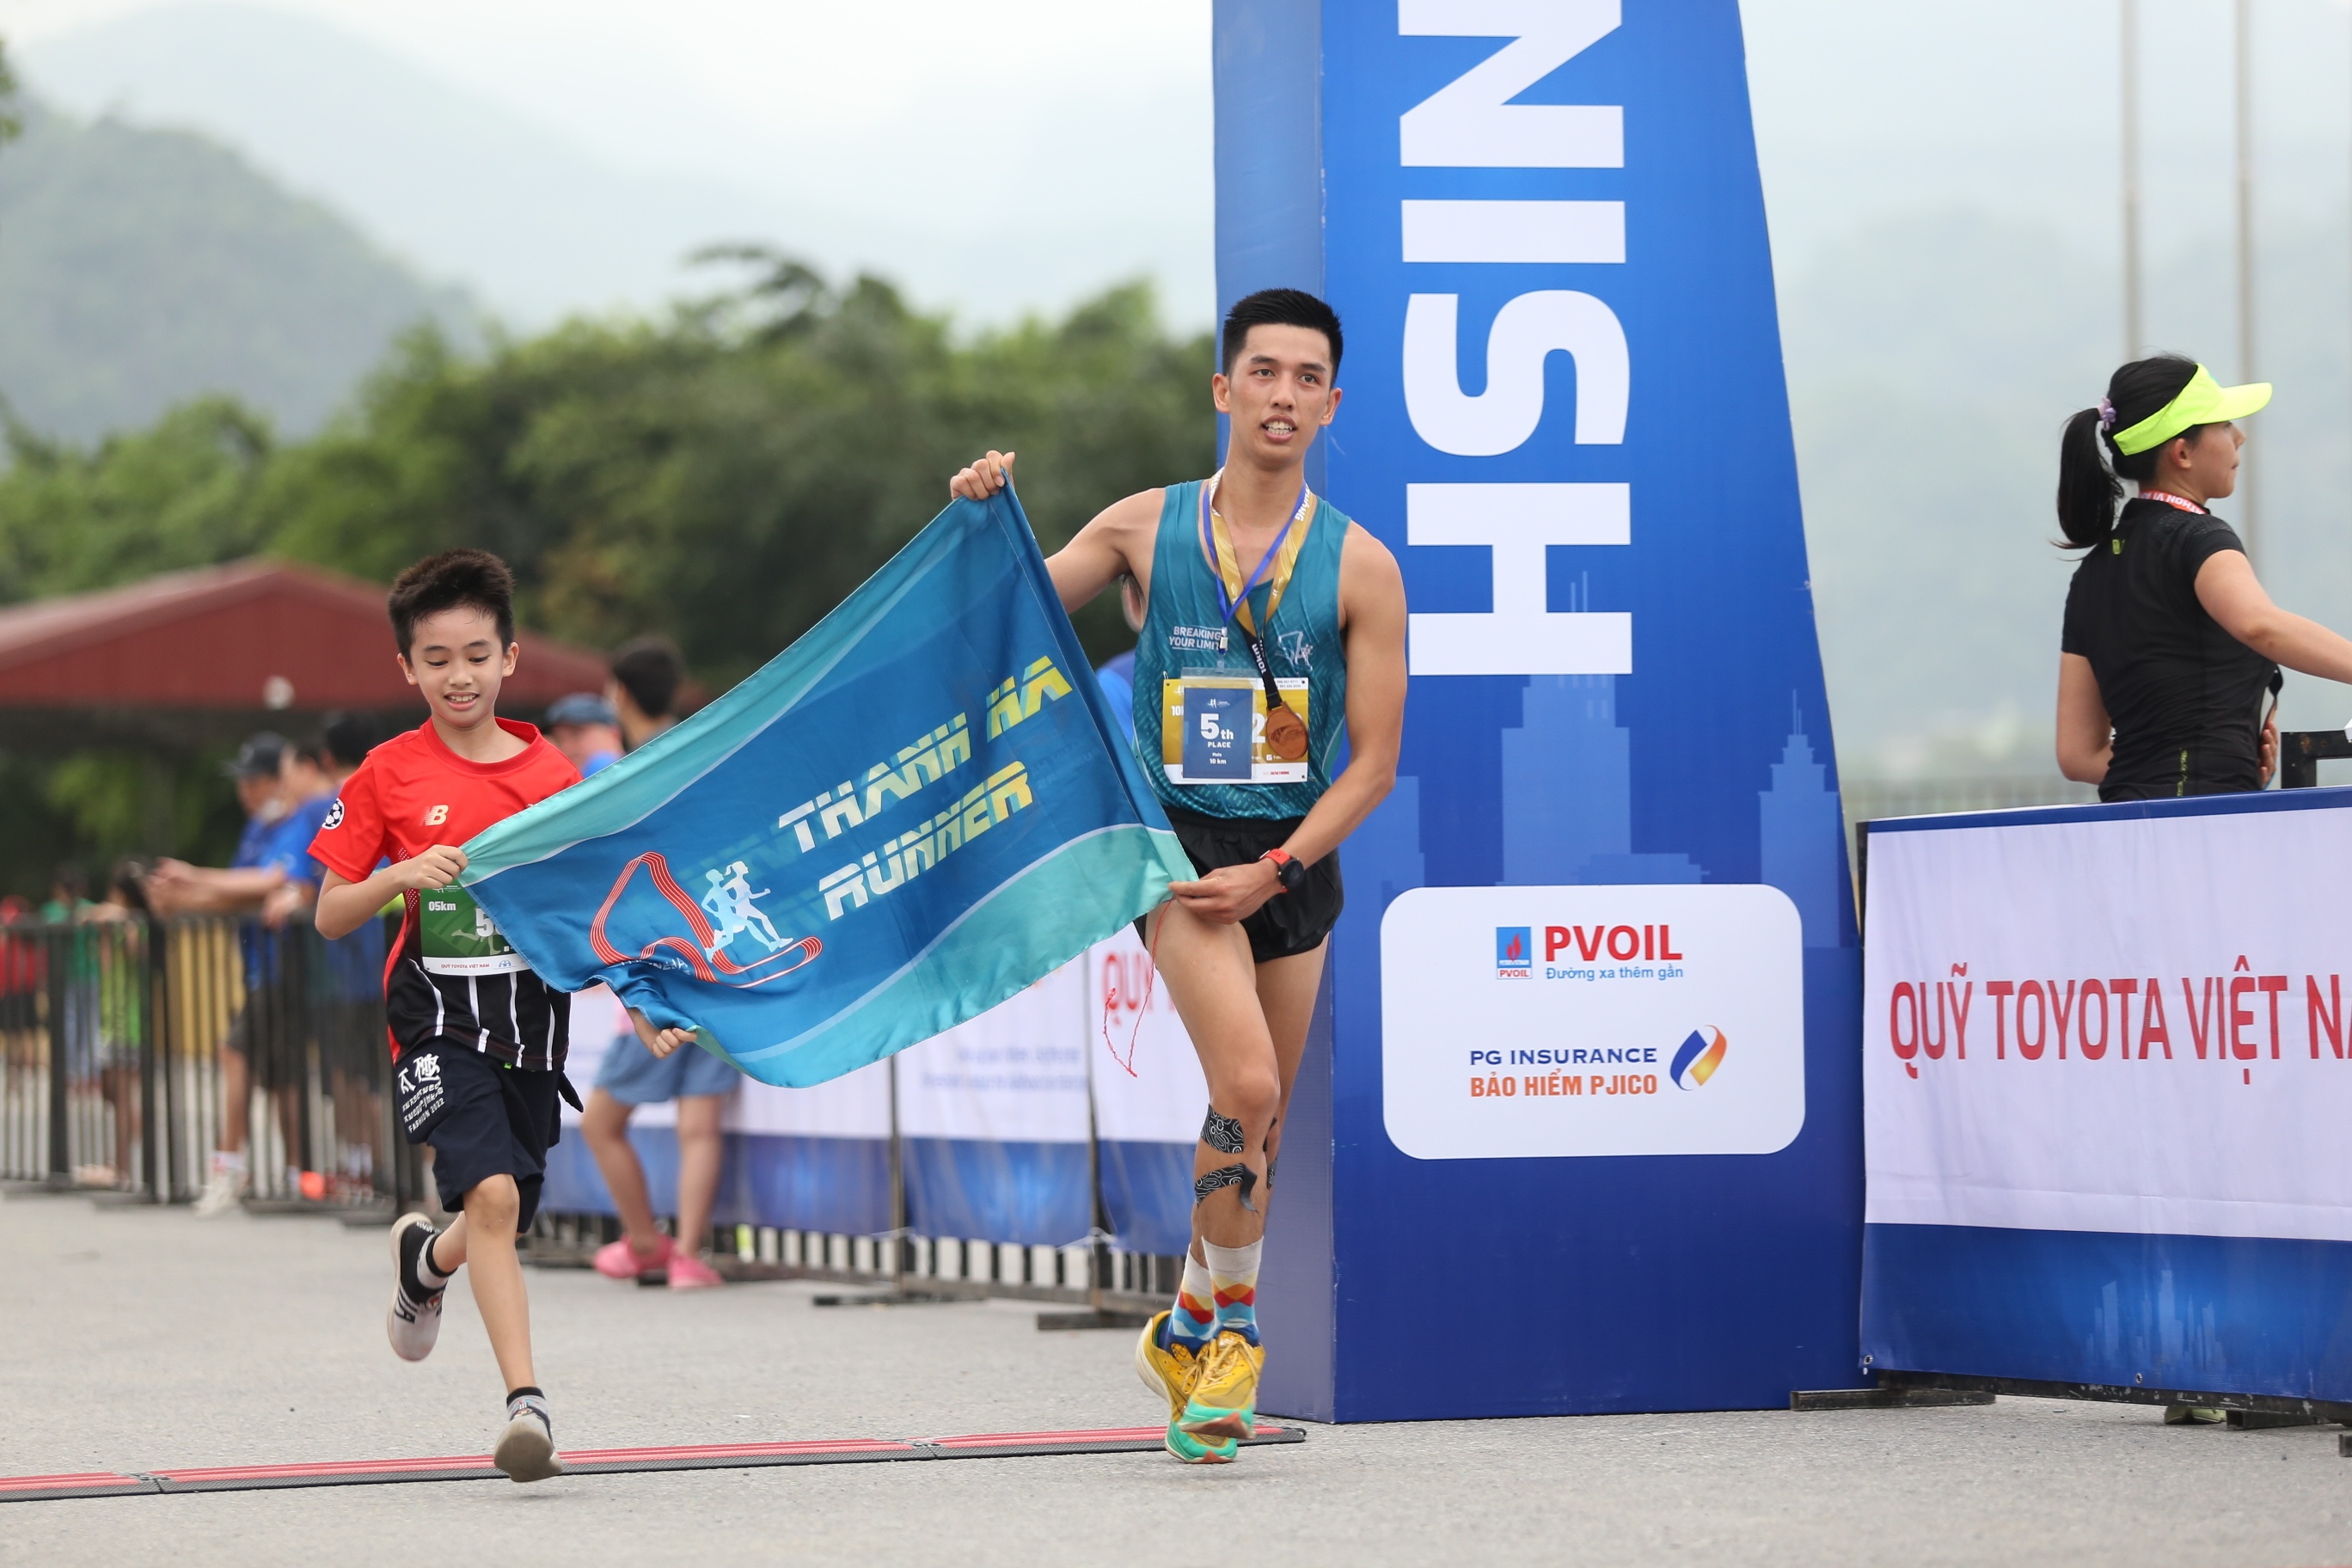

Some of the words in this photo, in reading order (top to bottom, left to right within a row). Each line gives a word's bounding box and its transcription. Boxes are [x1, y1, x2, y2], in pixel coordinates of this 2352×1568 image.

[1398, 0, 1632, 675] NISH
[1169, 636, 1195, 647] YOUR
[1173, 626, 1221, 640] BREAKING
[1252, 643, 1266, 674] 10km
[779, 713, 971, 853] THANH
[987, 655, 1073, 743] HA
[819, 761, 1032, 921] RUNNER
[429, 901, 456, 911] 05km
[475, 908, 504, 937] 5
[1545, 925, 1682, 961] PVOIL
[1546, 967, 1595, 981] Đường
[1599, 969, 1615, 978] xa
[1620, 966, 1653, 978] thêm
[1658, 964, 1683, 980] gần
[1890, 962, 1973, 1079] QUỸ
[1986, 978, 2173, 1061] TOYOTA
[2182, 955, 2288, 1085] VIỆT
[2306, 974, 2352, 1060] N
[1470, 1050, 1502, 1065] PG
[1510, 1048, 1657, 1065] INSURANCE
[1471, 1071, 1516, 1097] BẢO
[1524, 1068, 1582, 1096] HIỂM
[1590, 1075, 1657, 1095] PJICO
[430, 1098, 445, 1113] 2022
